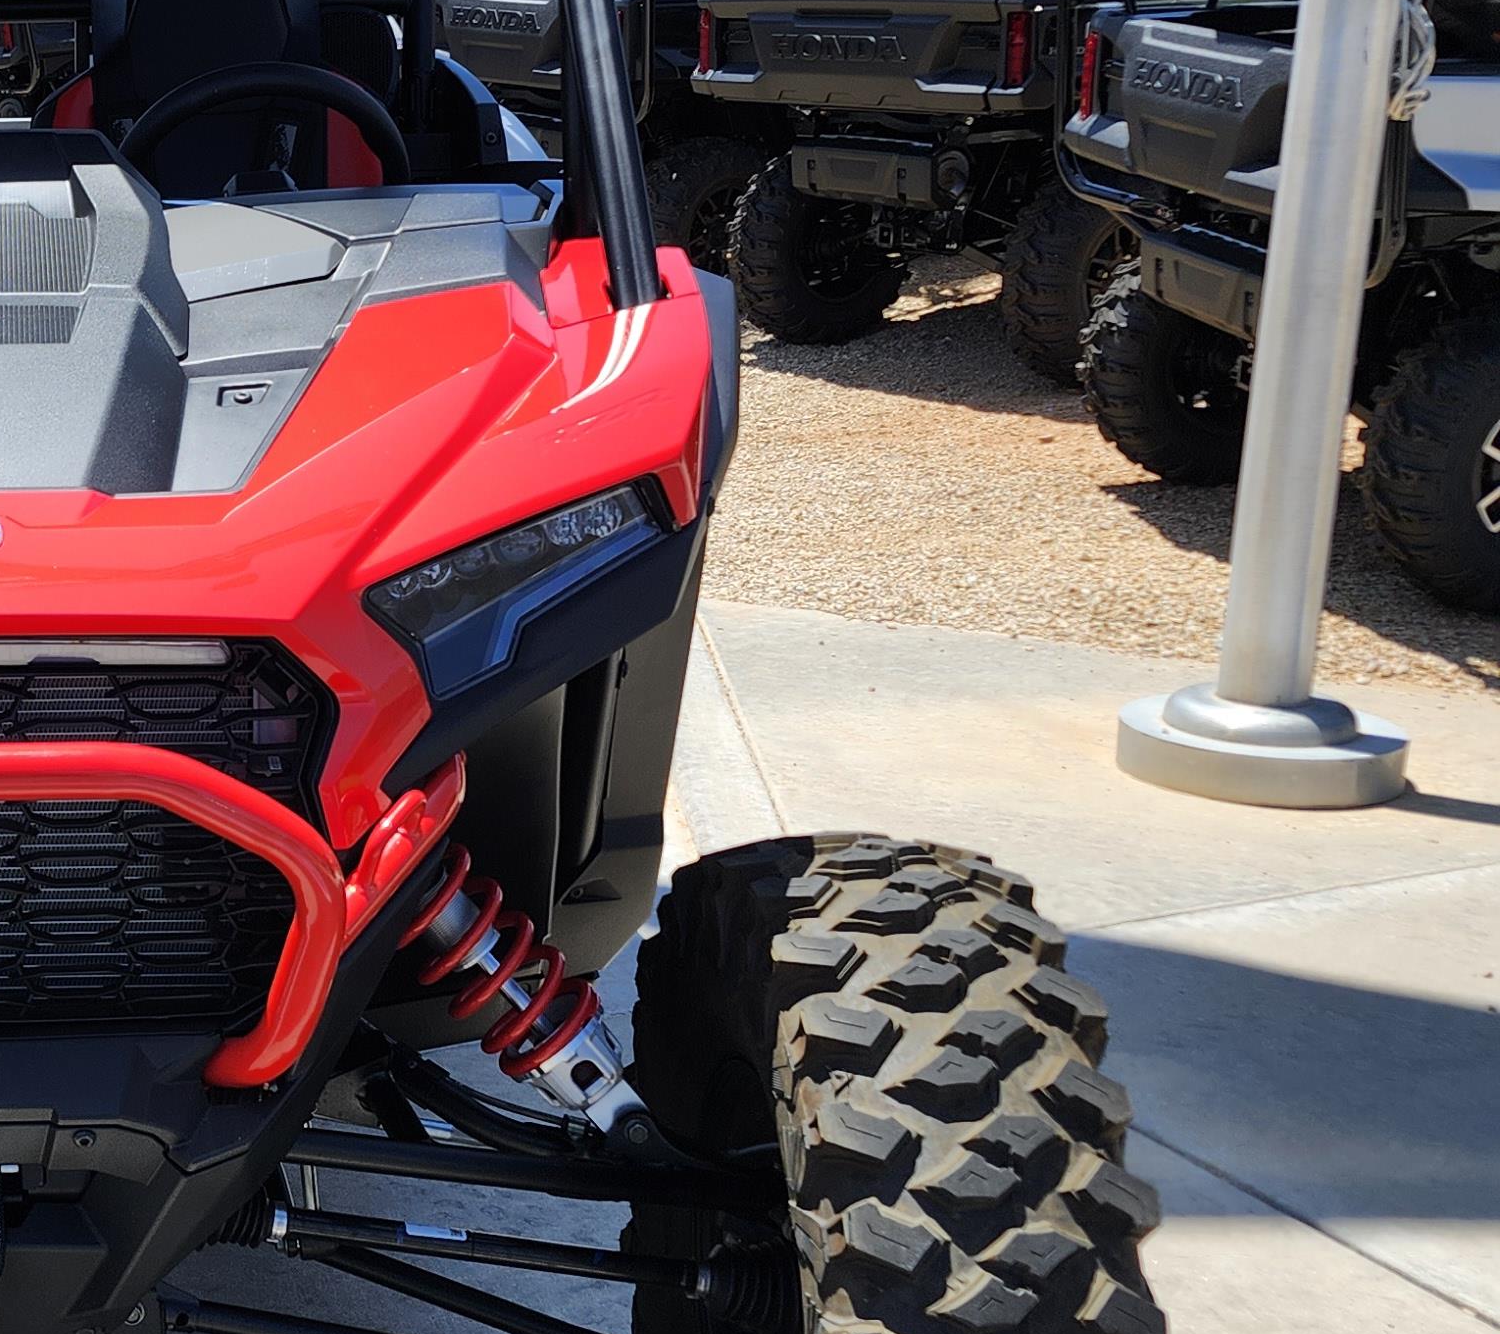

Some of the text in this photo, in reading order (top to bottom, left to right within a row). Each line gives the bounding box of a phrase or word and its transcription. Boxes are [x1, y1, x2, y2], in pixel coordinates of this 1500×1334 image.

[450, 5, 541, 35] HONDA
[770, 33, 907, 63] HONDA
[1130, 56, 1244, 110] HONDA
